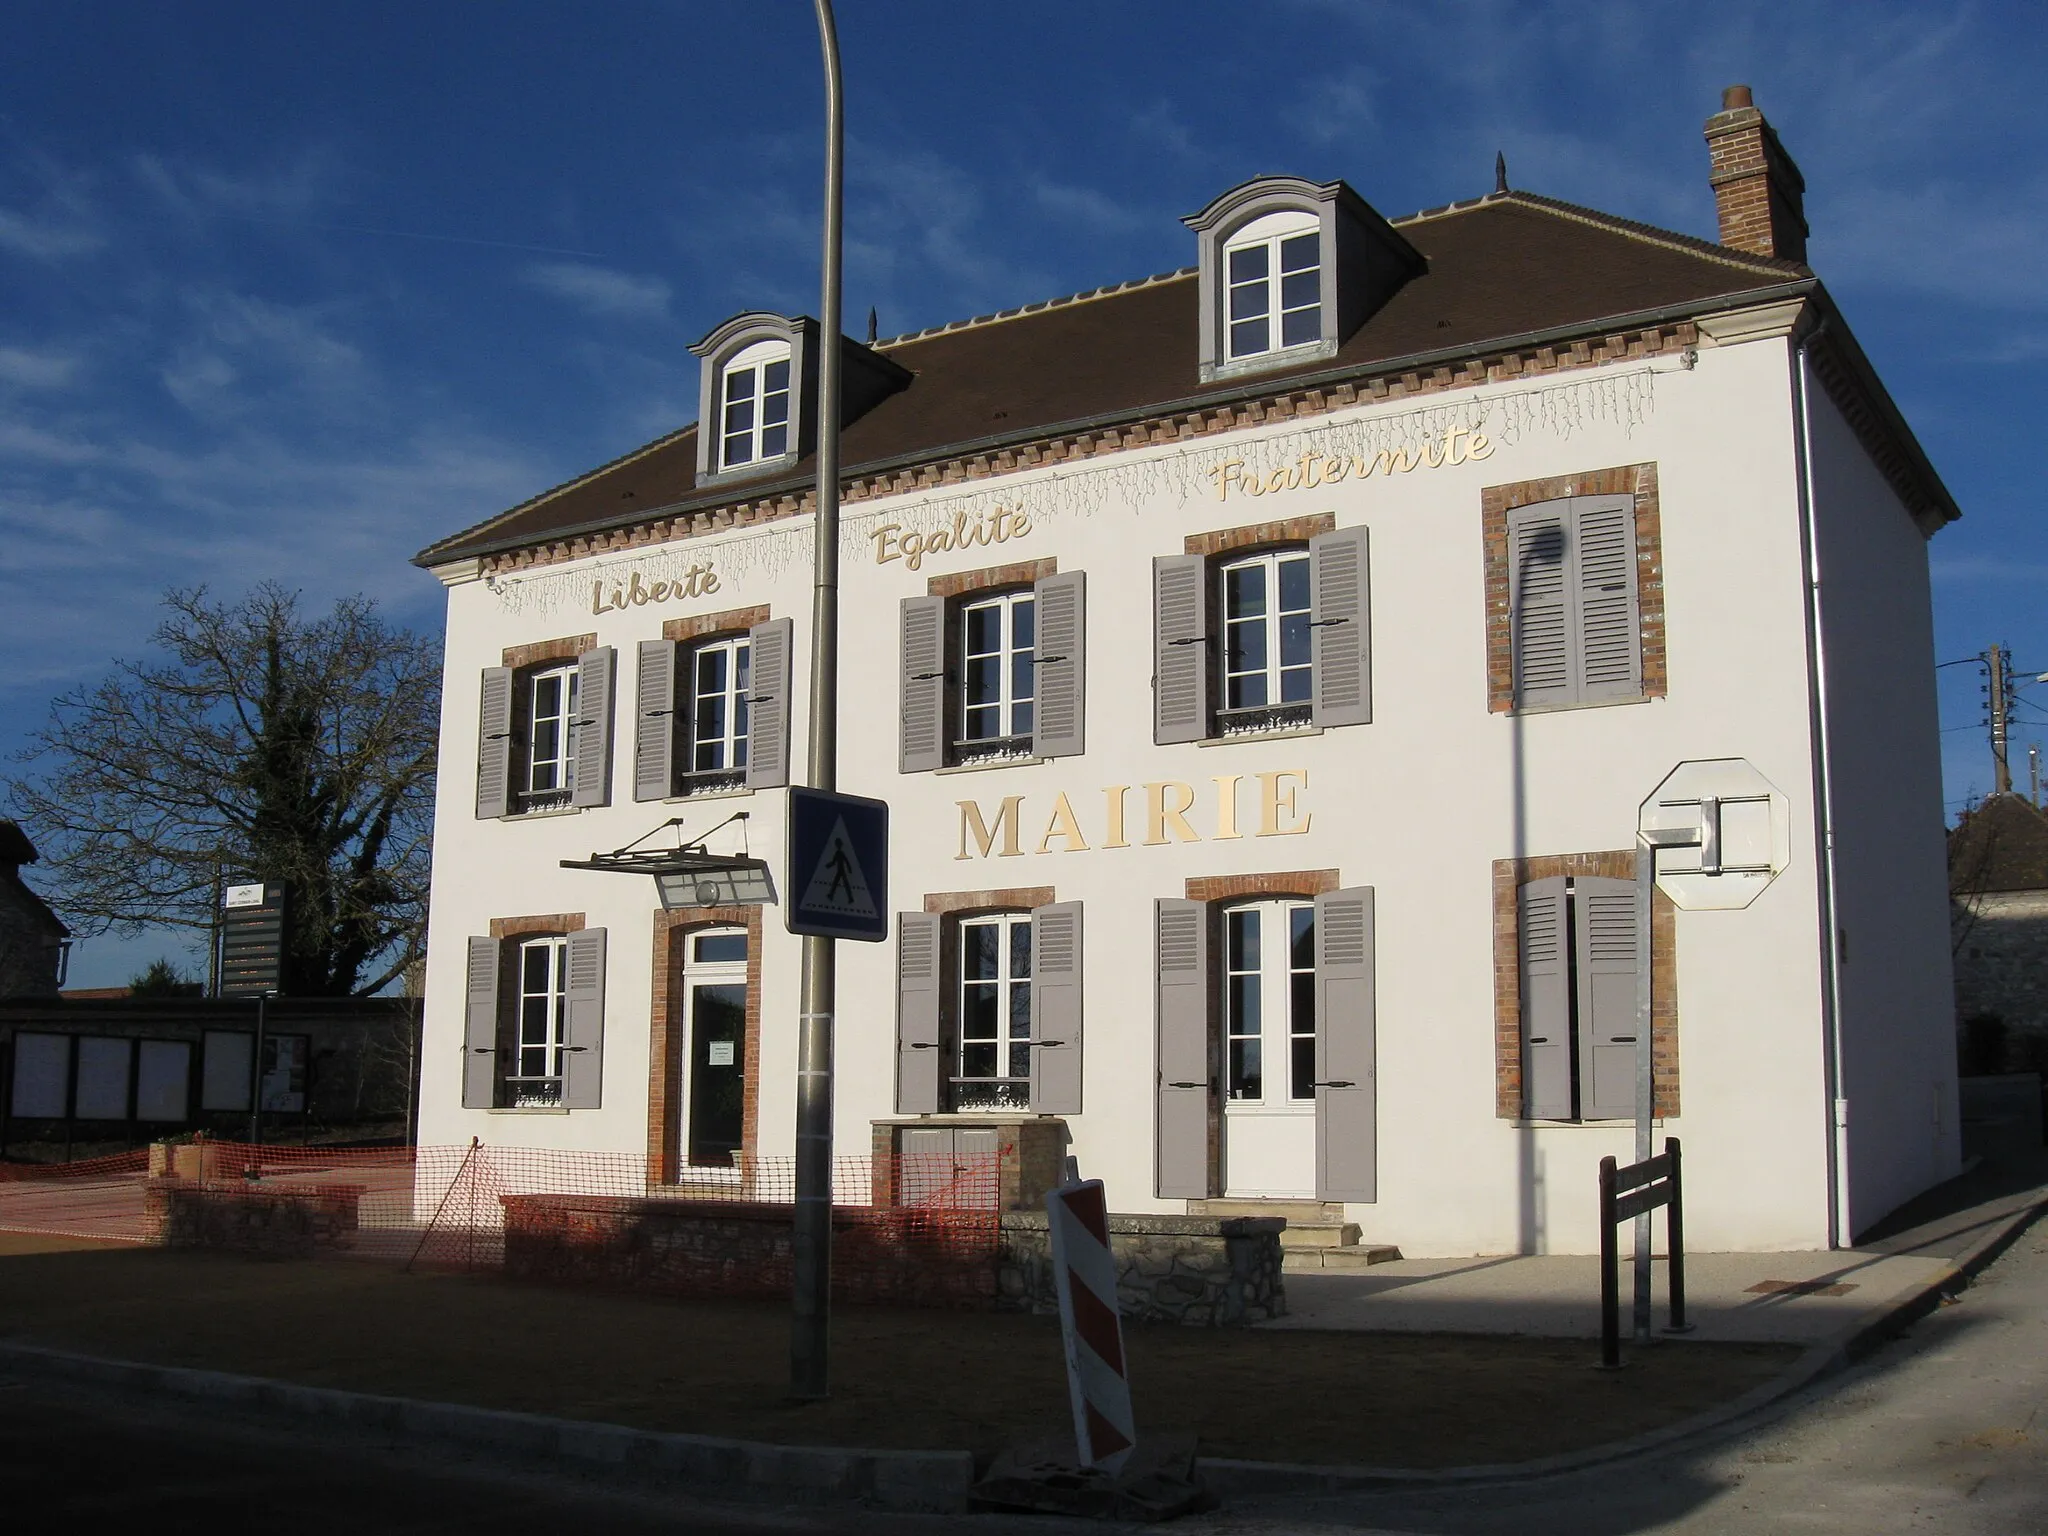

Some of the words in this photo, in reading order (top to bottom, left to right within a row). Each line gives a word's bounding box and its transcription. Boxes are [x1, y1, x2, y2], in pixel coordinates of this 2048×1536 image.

[592, 562, 721, 616] Liberté
[869, 502, 1033, 571] Egalité
[1208, 421, 1496, 501] Fraternité
[953, 769, 1313, 861] MAIRIE
